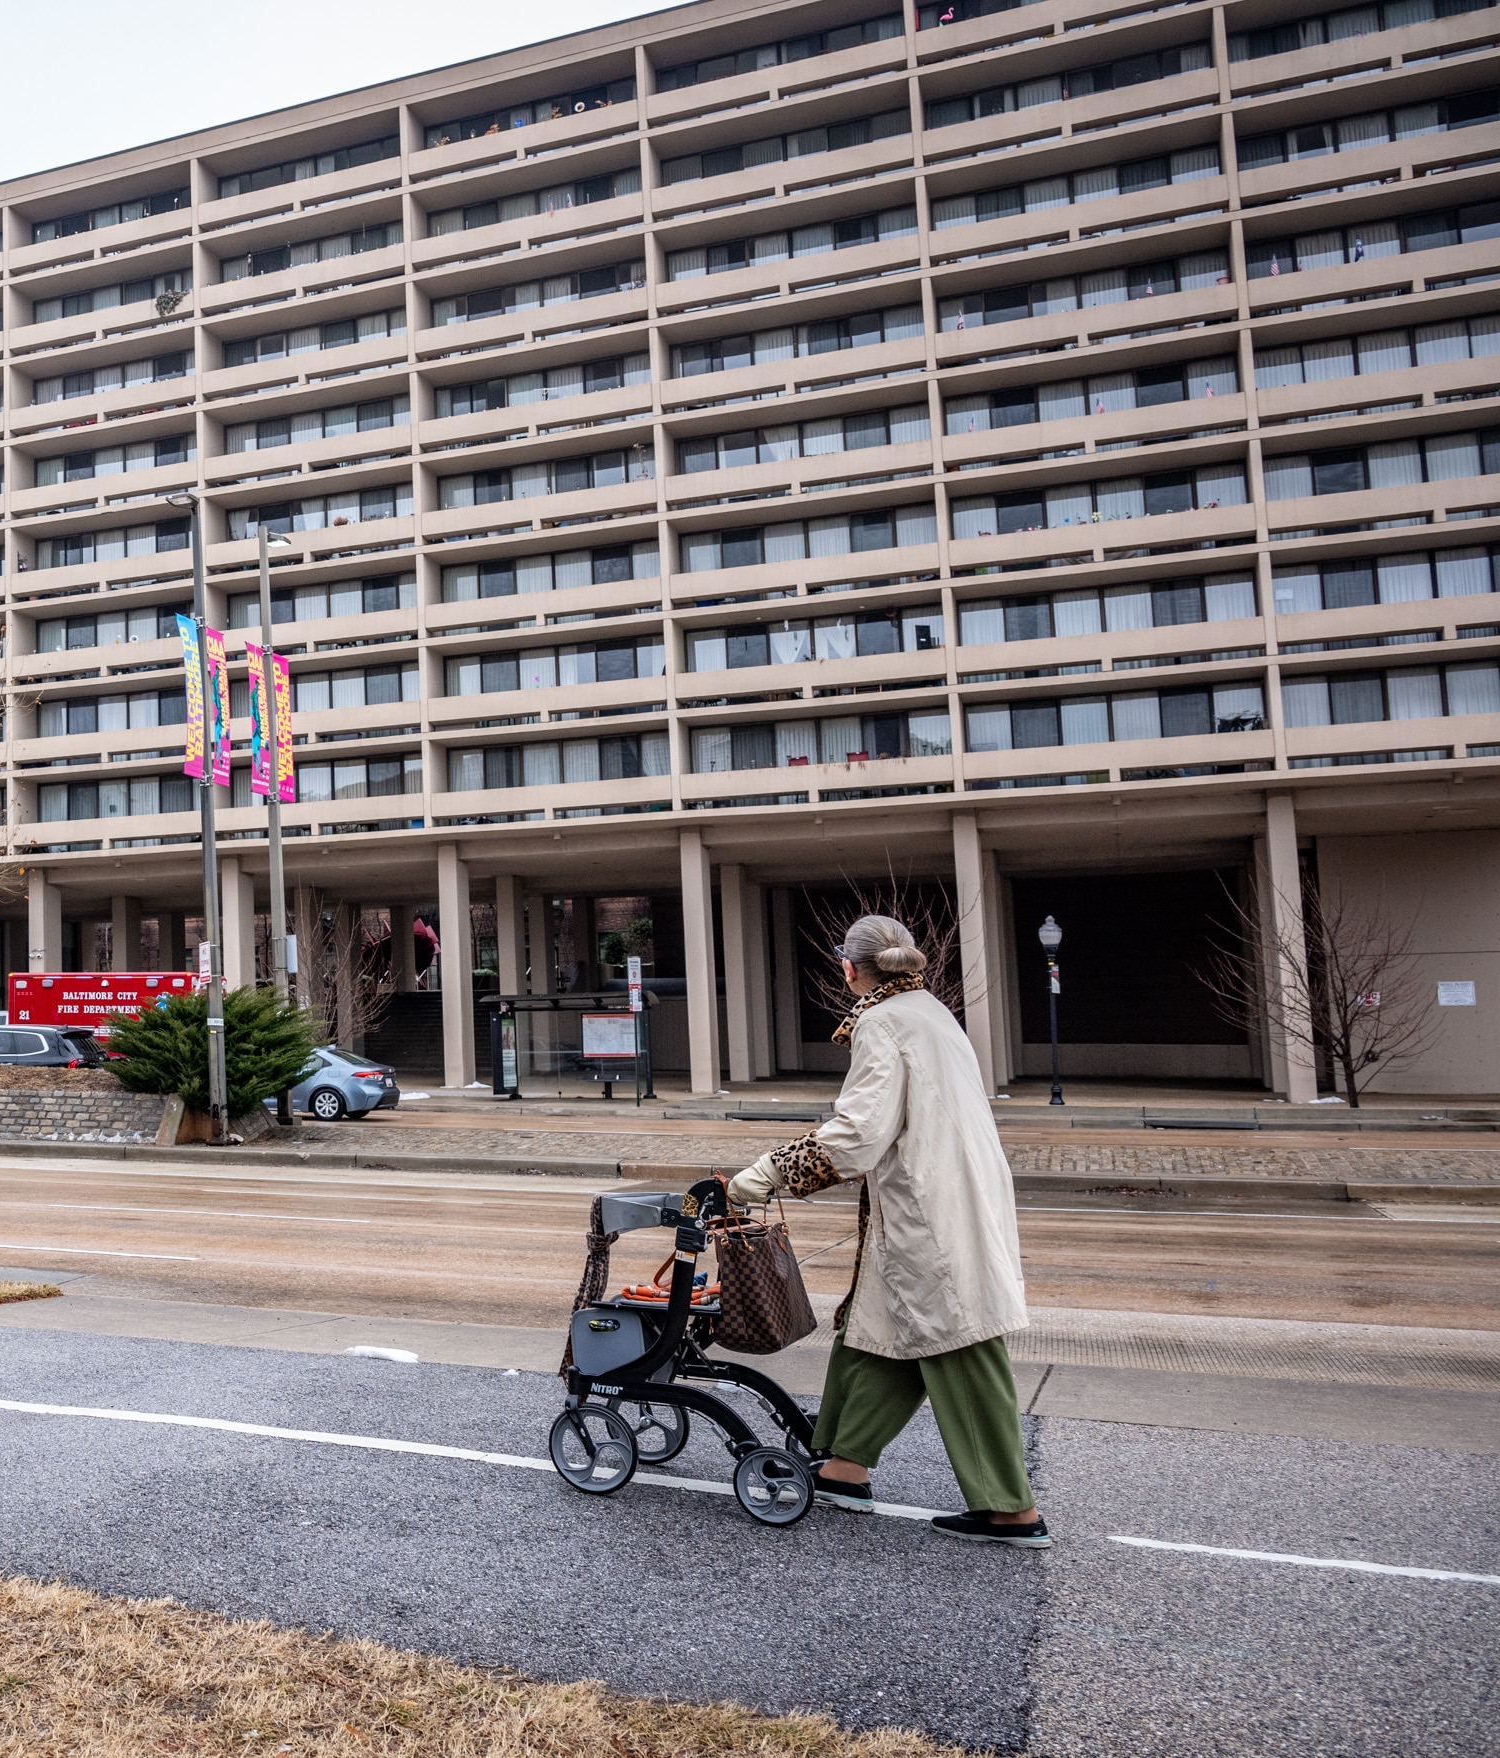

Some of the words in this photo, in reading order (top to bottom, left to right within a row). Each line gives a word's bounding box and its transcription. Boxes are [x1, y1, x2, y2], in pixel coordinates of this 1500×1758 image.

[179, 626, 190, 654] TO
[206, 635, 224, 656] CIAA
[273, 662, 283, 686] TO
[185, 659, 196, 762] WELCOME
[192, 640, 204, 757] BALTIMORE
[276, 691, 287, 782] WELCOME
[283, 674, 294, 777] BALTIMORE
[63, 992, 113, 1000] BALTIMORE
[117, 992, 138, 1000] CITY
[19, 1010, 30, 1020] 21
[57, 1005, 79, 1014] FIRE
[83, 1005, 142, 1014] DEPARTMENT
